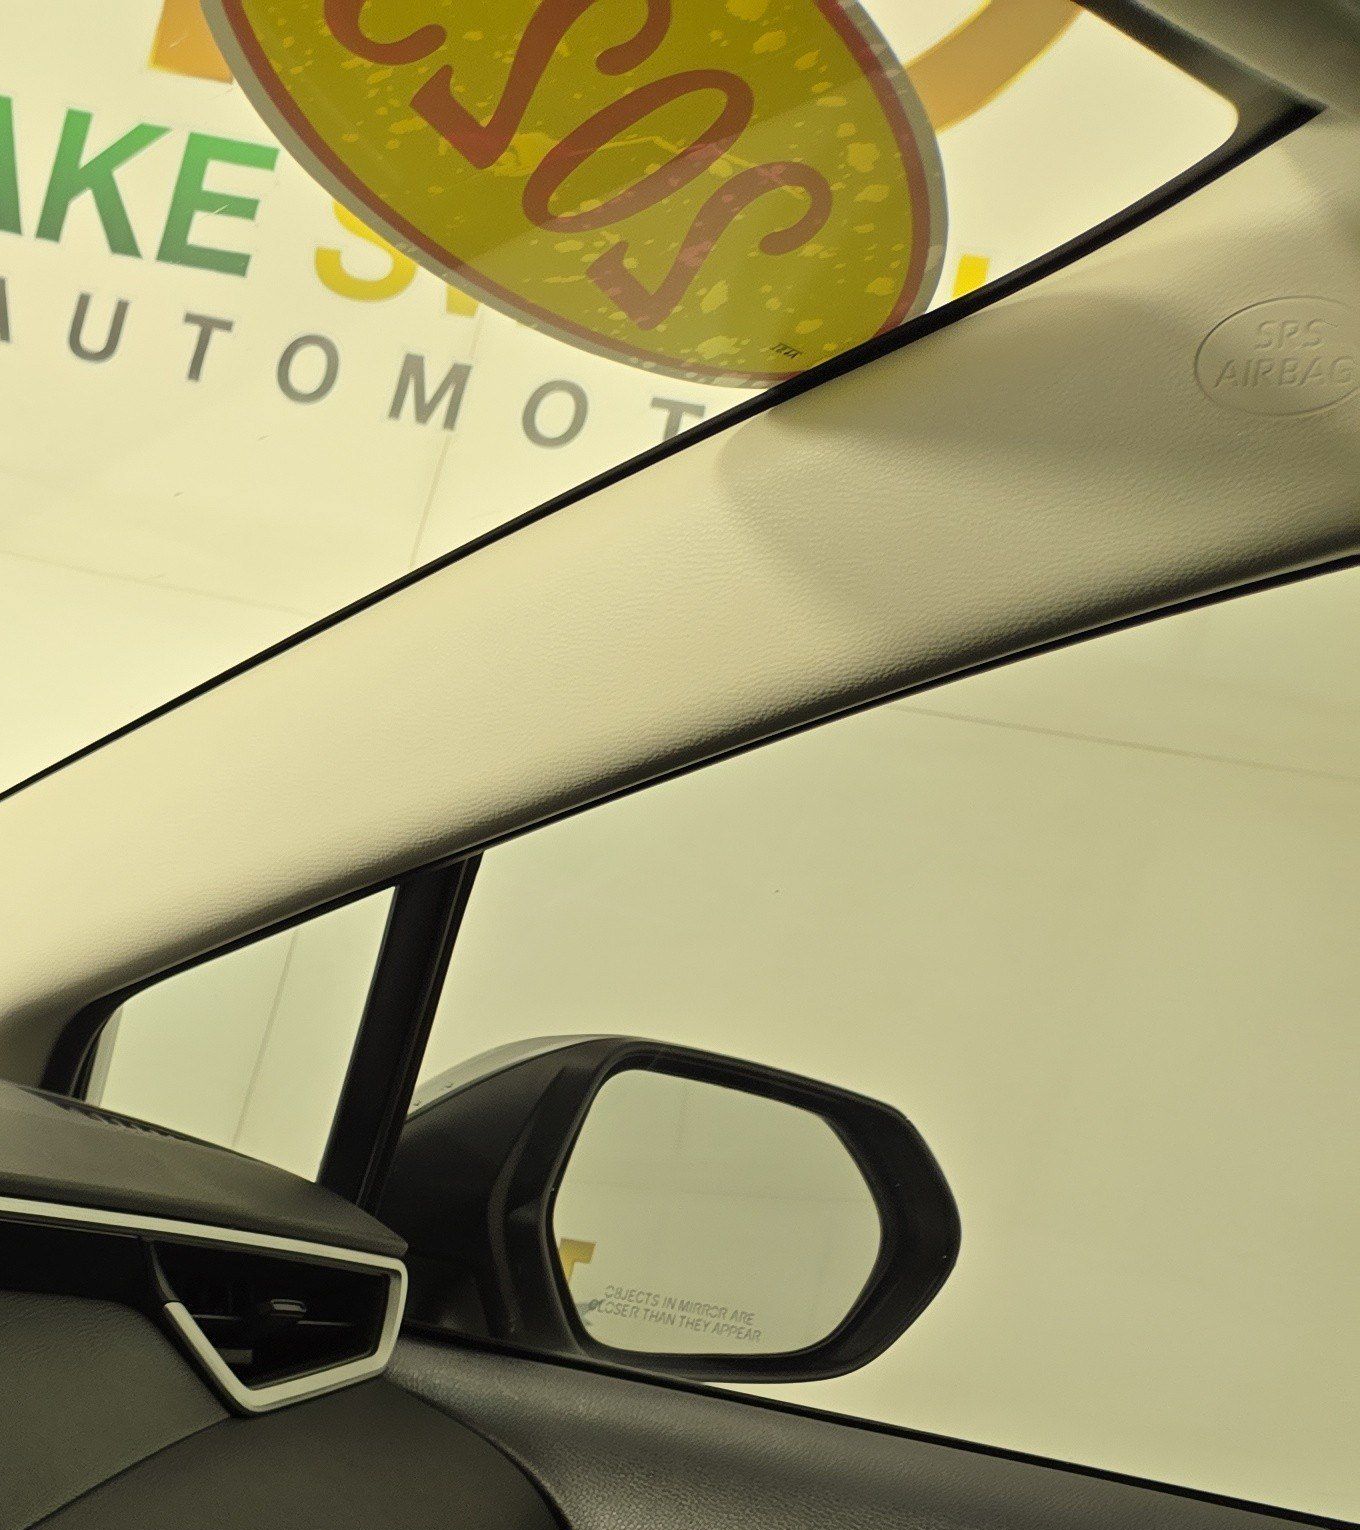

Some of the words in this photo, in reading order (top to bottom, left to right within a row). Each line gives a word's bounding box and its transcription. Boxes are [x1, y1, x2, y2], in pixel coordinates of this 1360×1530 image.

[1254, 319, 1338, 350] SRS
[1214, 355, 1357, 388] AIRBAG
[604, 1285, 660, 1307] OBJECTS
[663, 1297, 676, 1310] IN
[678, 1299, 728, 1320] MIRROR
[730, 1309, 755, 1326] ARE
[642, 1308, 676, 1326] THAN
[679, 1315, 711, 1333] THEY
[711, 1322, 762, 1343] APPEAR
